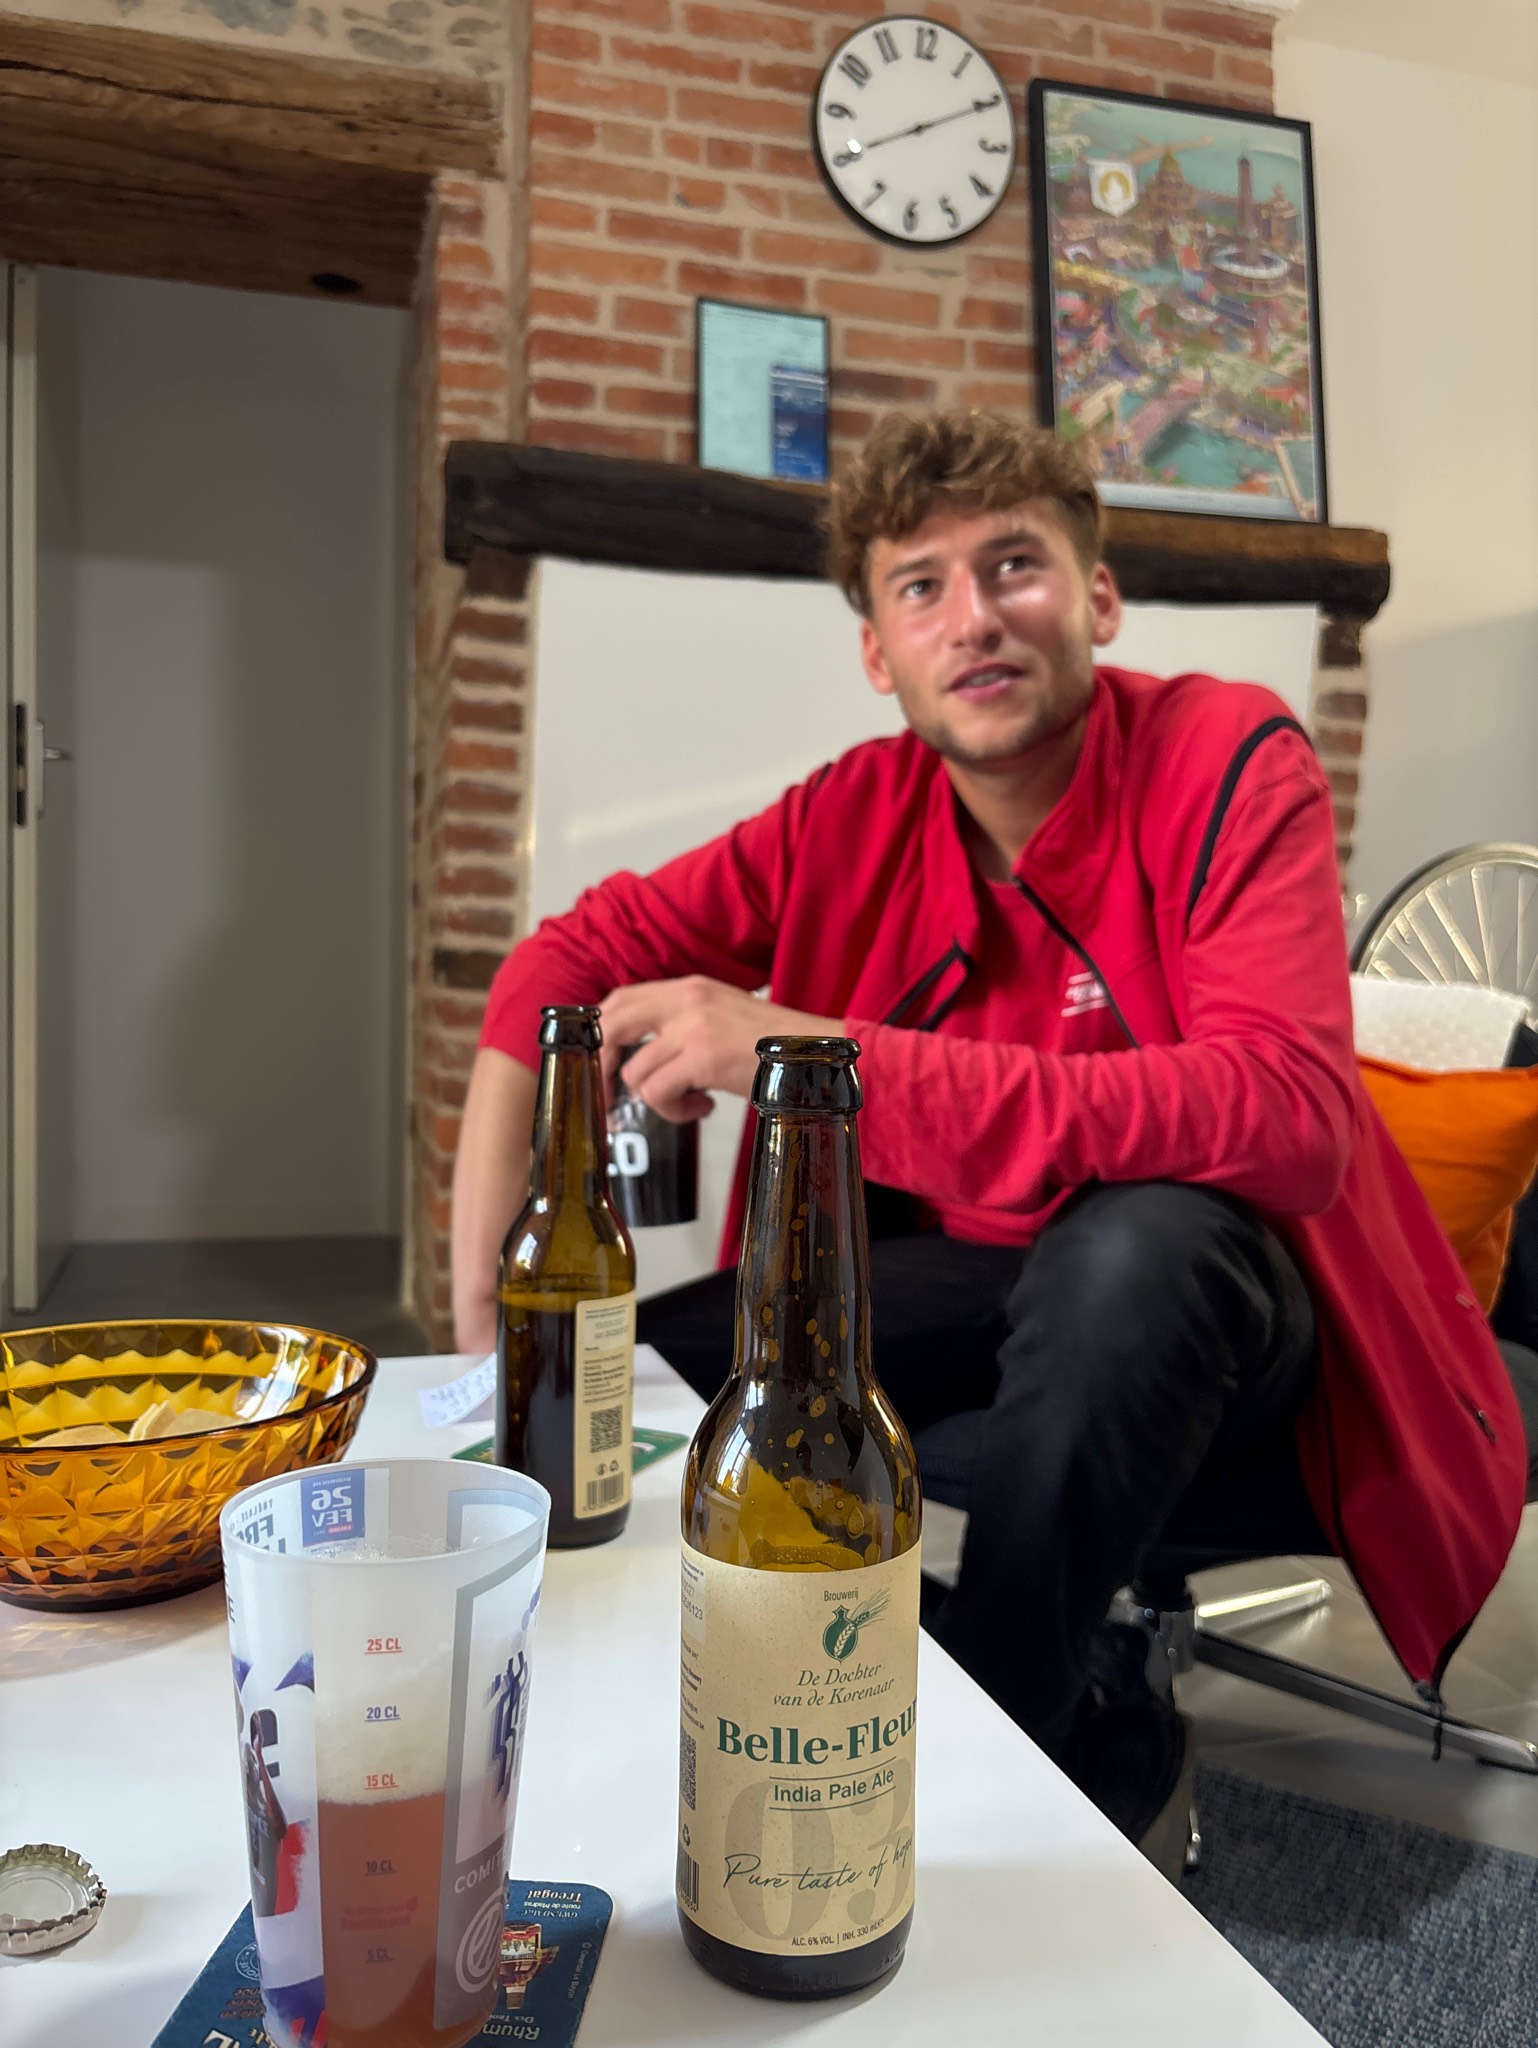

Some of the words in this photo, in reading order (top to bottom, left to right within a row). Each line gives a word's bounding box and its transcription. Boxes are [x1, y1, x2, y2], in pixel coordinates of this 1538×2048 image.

[874, 28, 902, 64] 11
[914, 26, 939, 61] 12
[838, 54, 872, 90] 10
[950, 51, 973, 79] 1
[825, 103, 856, 121] 9
[978, 137, 1007, 155] 3
[860, 178, 888, 210] 7
[969, 174, 995, 198] 4
[903, 200, 920, 233] 6
[938, 195, 961, 229] 5
[823, 1587, 859, 1601] Brouwerij
[367, 1638, 382, 1651] 25
[386, 1637, 401, 1650] CL
[797, 1669, 820, 1686] De
[824, 1663, 882, 1685] Dochter
[773, 1693, 802, 1706] van
[807, 1689, 825, 1706] de
[828, 1678, 894, 1705] Korenaar
[366, 1706, 381, 1719] 20
[384, 1705, 400, 1718] CL
[366, 1774, 379, 1787] 15
[381, 1773, 396, 1786] CL
[774, 1785, 821, 1802] India
[829, 1779, 867, 1800] Pale
[872, 1769, 894, 1790] Ale
[366, 1861, 378, 1873] 10
[380, 1860, 393, 1872] CL
[723, 1853, 789, 1888] Pure
[778, 1862, 863, 1890] taste
[869, 1845, 889, 1888] of
[791, 1937, 806, 1946] ALC.
[808, 1937, 819, 1945] 6%
[842, 1932, 854, 1941] INH.
[857, 1927, 868, 1937] 330
[367, 1949, 375, 1960] 5
[377, 1948, 389, 1960] CL
[482, 2023, 541, 2041] Rhum
